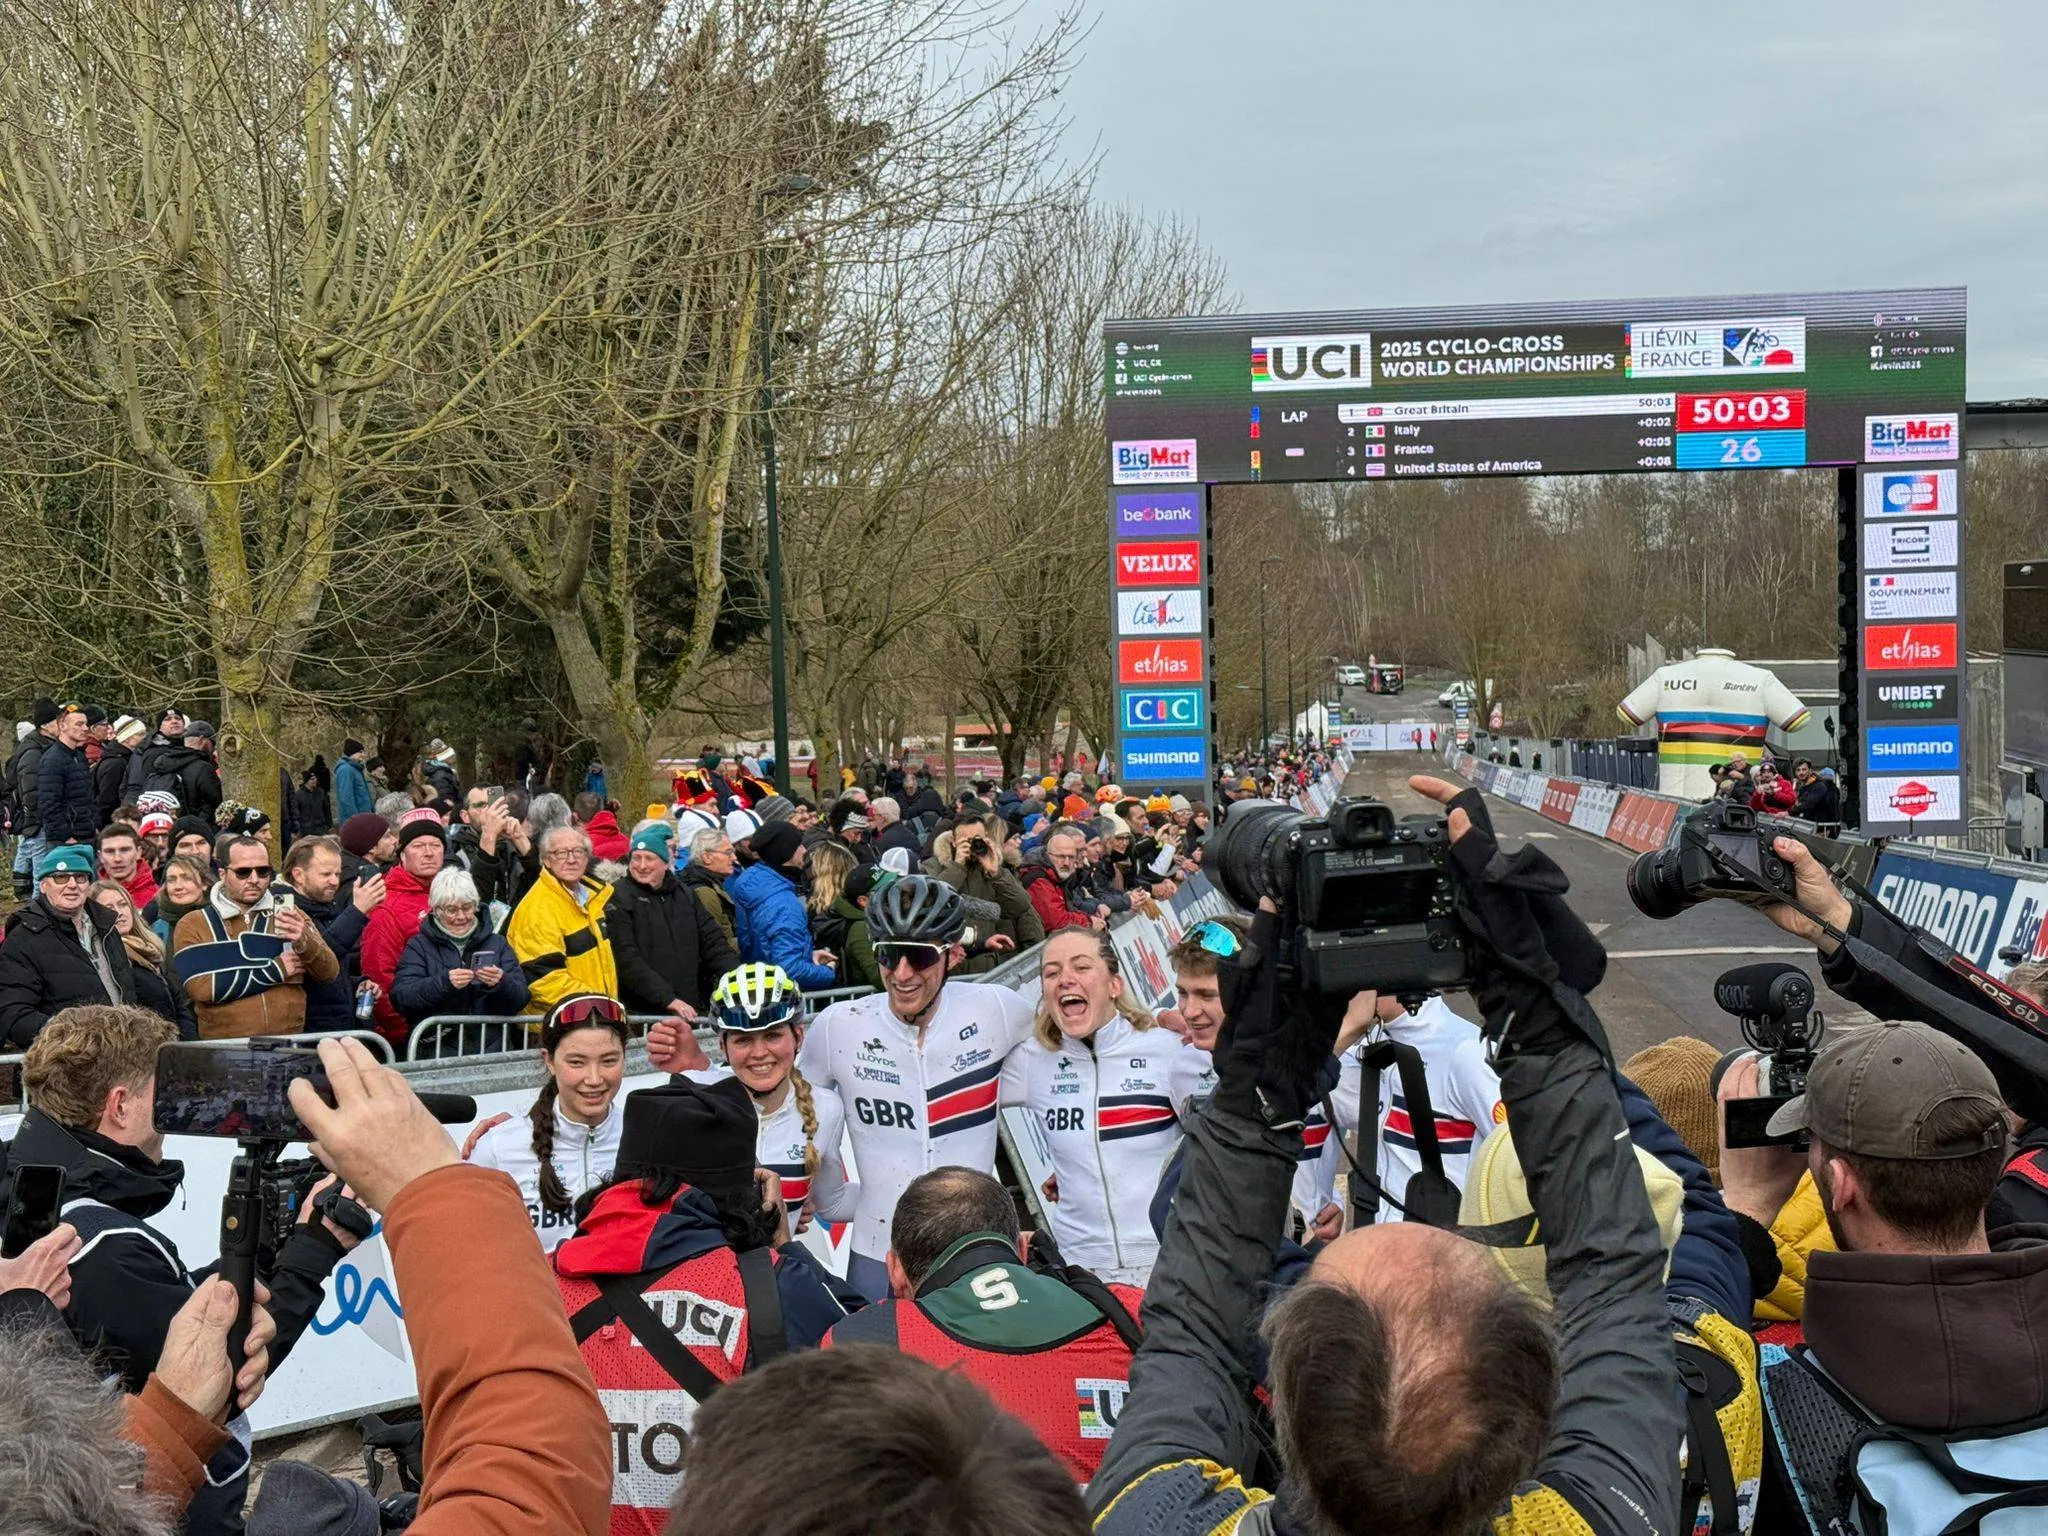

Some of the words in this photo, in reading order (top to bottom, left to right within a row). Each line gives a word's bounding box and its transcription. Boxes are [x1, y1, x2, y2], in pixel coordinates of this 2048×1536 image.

[1381, 341, 1421, 358] 2025
[1425, 335, 1564, 356] CYCLO-CROSS
[1641, 327, 1697, 349] LIÉVIN
[1270, 343, 1360, 381] UCI
[1381, 360, 1452, 377] WORLD
[1454, 353, 1616, 375] CHAMPIONSHIPS
[1641, 349, 1712, 368] FRANCE
[1280, 410, 1308, 423] LAP
[1348, 408, 1354, 417] 1
[1394, 404, 1427, 417] Great
[1430, 403, 1469, 415] Britain
[1638, 397, 1672, 408] 50:03
[1693, 397, 1791, 424] 50:03
[1347, 427, 1355, 436] 2
[1394, 425, 1420, 438] Italy
[1637, 417, 1672, 428] +0:02
[1872, 421, 1951, 446] BigMat
[1119, 447, 1190, 470] BigMat
[1347, 446, 1355, 456] 3
[1394, 444, 1434, 455] France
[1721, 438, 1762, 463] 26
[1347, 465, 1355, 476] 4
[1394, 463, 1435, 475] United
[1437, 463, 1474, 474] States
[1477, 462, 1489, 472] of
[1492, 460, 1542, 472] America
[1121, 553, 1193, 573] VELUX
[1868, 586, 1950, 598] GOUVERNEMENT
[1880, 629, 1941, 663] ethias
[1134, 644, 1188, 675] ethias
[1670, 680, 1697, 691] UCI
[1723, 682, 1758, 692] Santini
[1878, 685, 1945, 702] UNIBET
[1127, 750, 1200, 765] SHIMANO
[1871, 740, 1954, 756] SHIMANO
[1891, 790, 1936, 807] Pauwels
[1969, 973, 2013, 1006] EOS
[2014, 1004, 2039, 1023] 6D
[856, 1052, 897, 1067] LLOYDS
[1054, 1072, 1078, 1080] LLOYDS
[854, 1097, 917, 1130] GBR
[1045, 1107, 1085, 1131] GBR
[970, 1267, 1019, 1310] S
[653, 1299, 735, 1348] UCI
